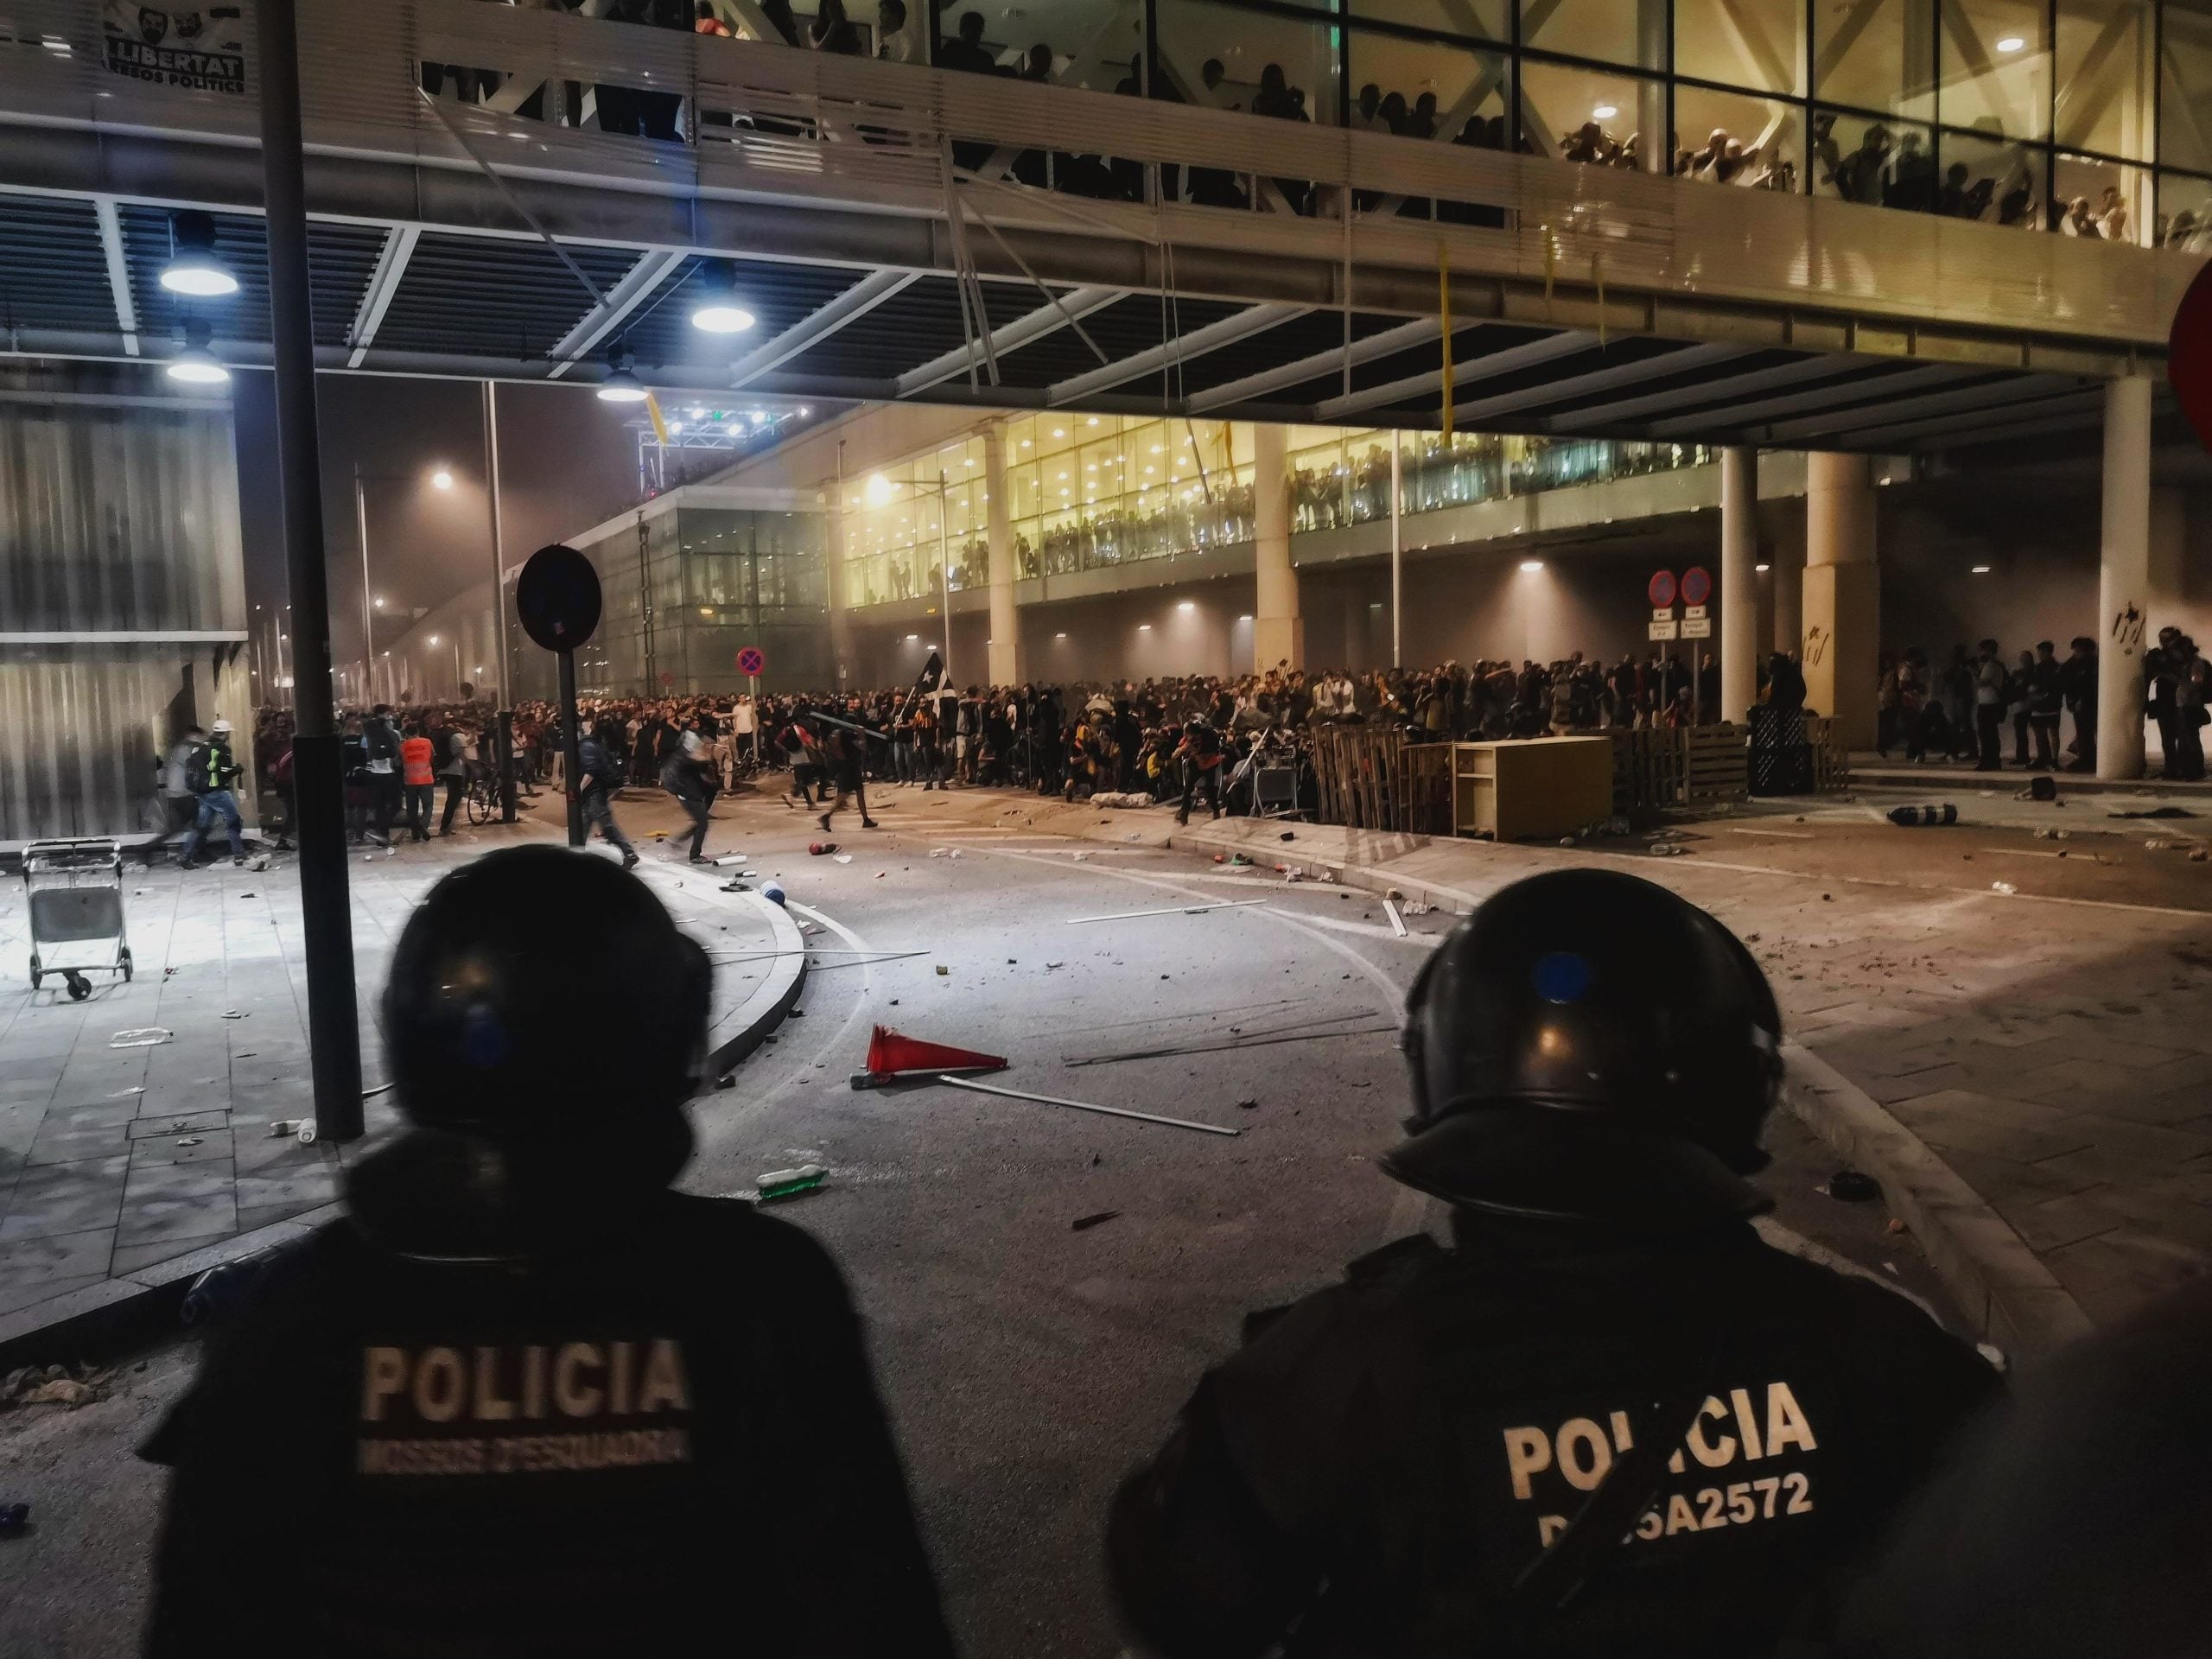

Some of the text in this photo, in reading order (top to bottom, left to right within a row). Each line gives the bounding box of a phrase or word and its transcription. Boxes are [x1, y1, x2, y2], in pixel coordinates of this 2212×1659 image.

[118, 41, 239, 77] LIBERTAT
[361, 1338, 691, 1421] POLICIA
[1503, 1382, 1818, 1500] POCIA
